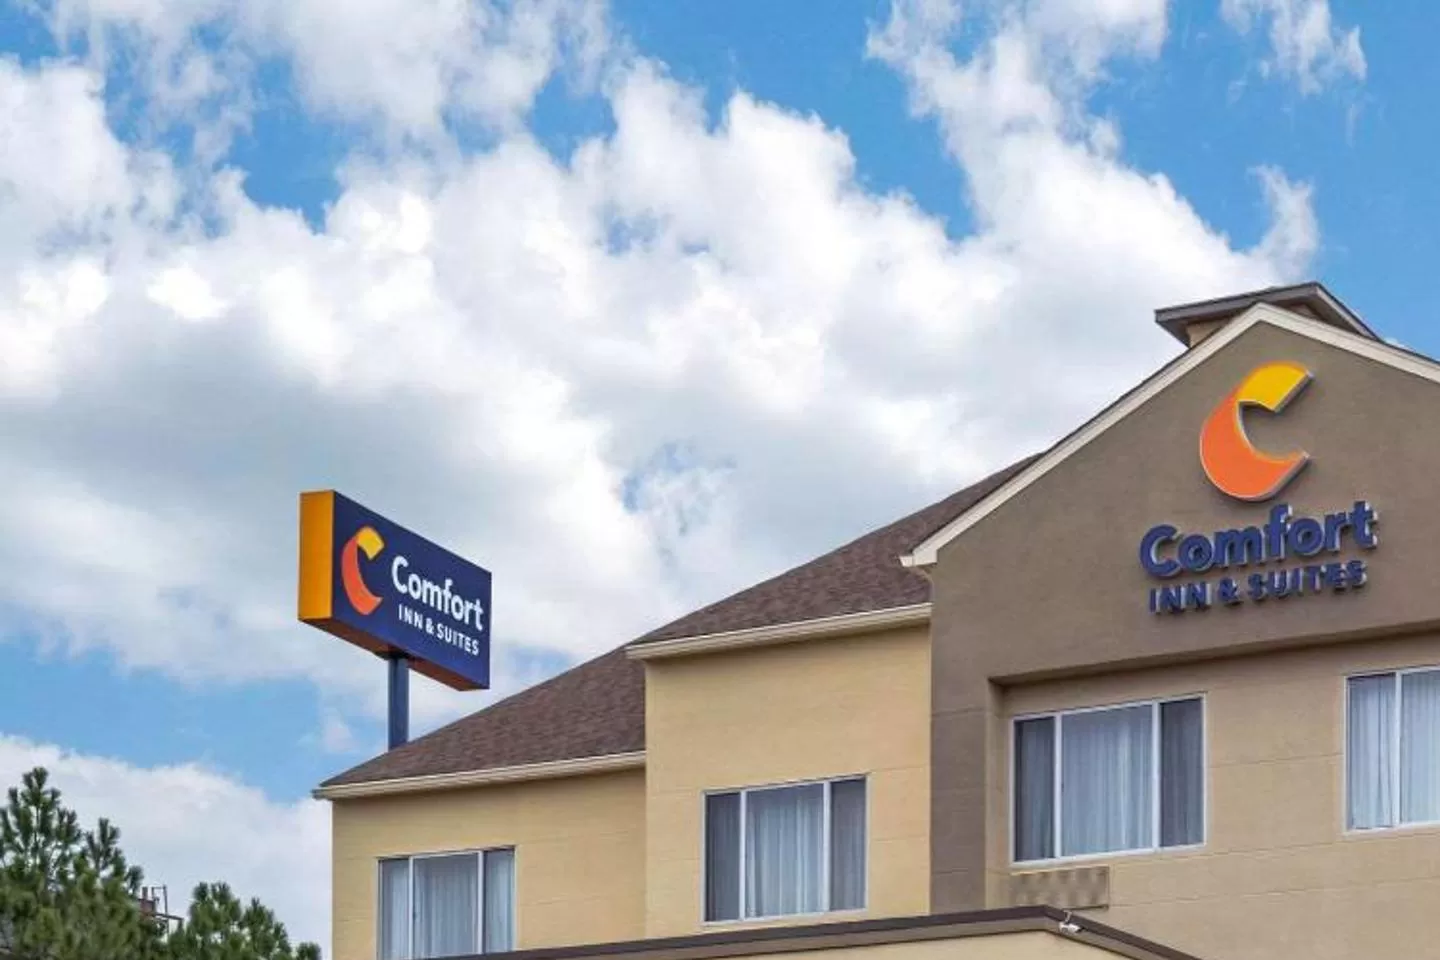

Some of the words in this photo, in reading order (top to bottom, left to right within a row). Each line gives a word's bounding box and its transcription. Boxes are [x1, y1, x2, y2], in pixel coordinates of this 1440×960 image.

[1140, 501, 1378, 579] Comfort
[391, 555, 483, 632] Comfort
[1149, 581, 1211, 614] INN
[1217, 578, 1241, 604] &
[1248, 559, 1367, 600] SUITES
[399, 604, 423, 629] INN
[425, 617, 435, 634] &
[436, 625, 479, 656] SUITES
